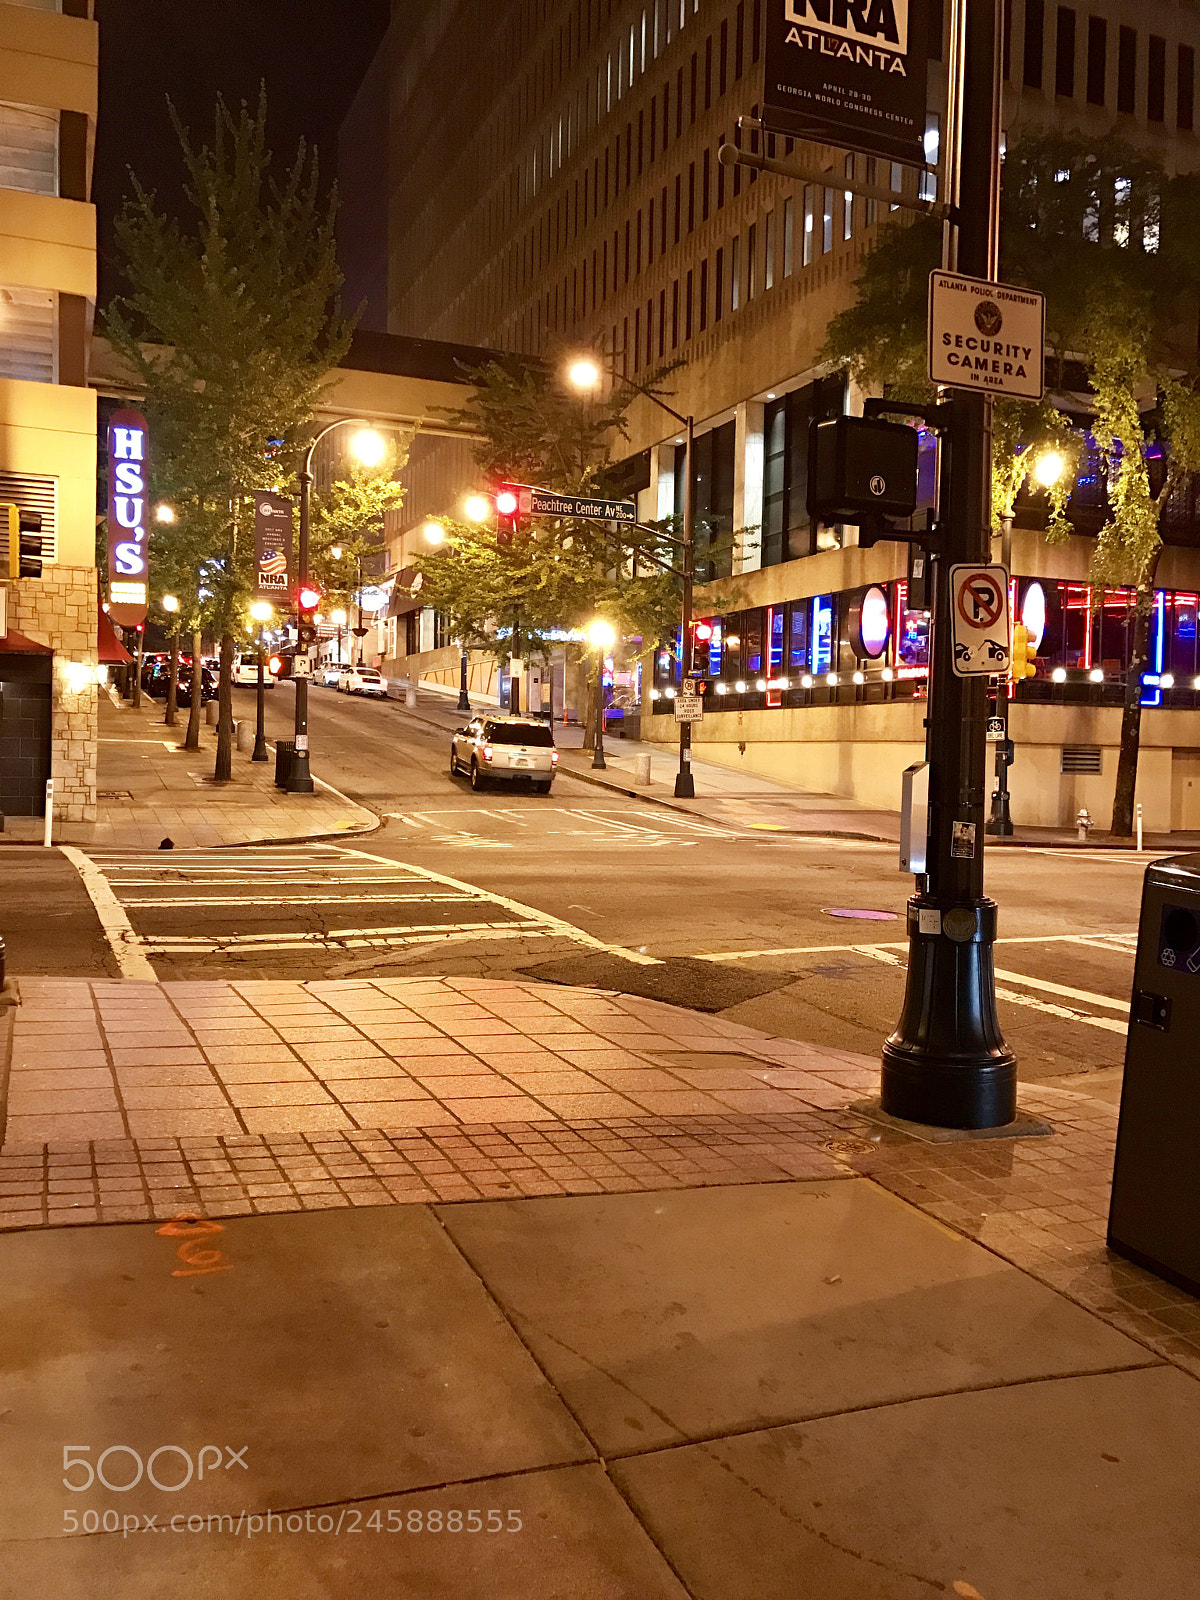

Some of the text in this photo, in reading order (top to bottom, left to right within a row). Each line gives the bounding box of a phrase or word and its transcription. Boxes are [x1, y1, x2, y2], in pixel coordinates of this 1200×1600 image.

[784, 27, 907, 77] ATLANTA
[827, 37, 840, 50] 17
[822, 82, 846, 95] APRIL
[777, 83, 914, 126] GEORGIA WORLD CONGRESS CENTER
[938, 279, 1038, 306] ATLANTA POLICE DEPARTMENT
[942, 332, 1032, 361] SECURITY
[947, 352, 1027, 379] CAMERA
[970, 373, 1004, 386] IN AREA
[113, 427, 145, 576] HSU'S
[531, 497, 616, 517] Peachtree Center Av
[615, 511, 627, 520] 200
[260, 573, 286, 585] NRA
